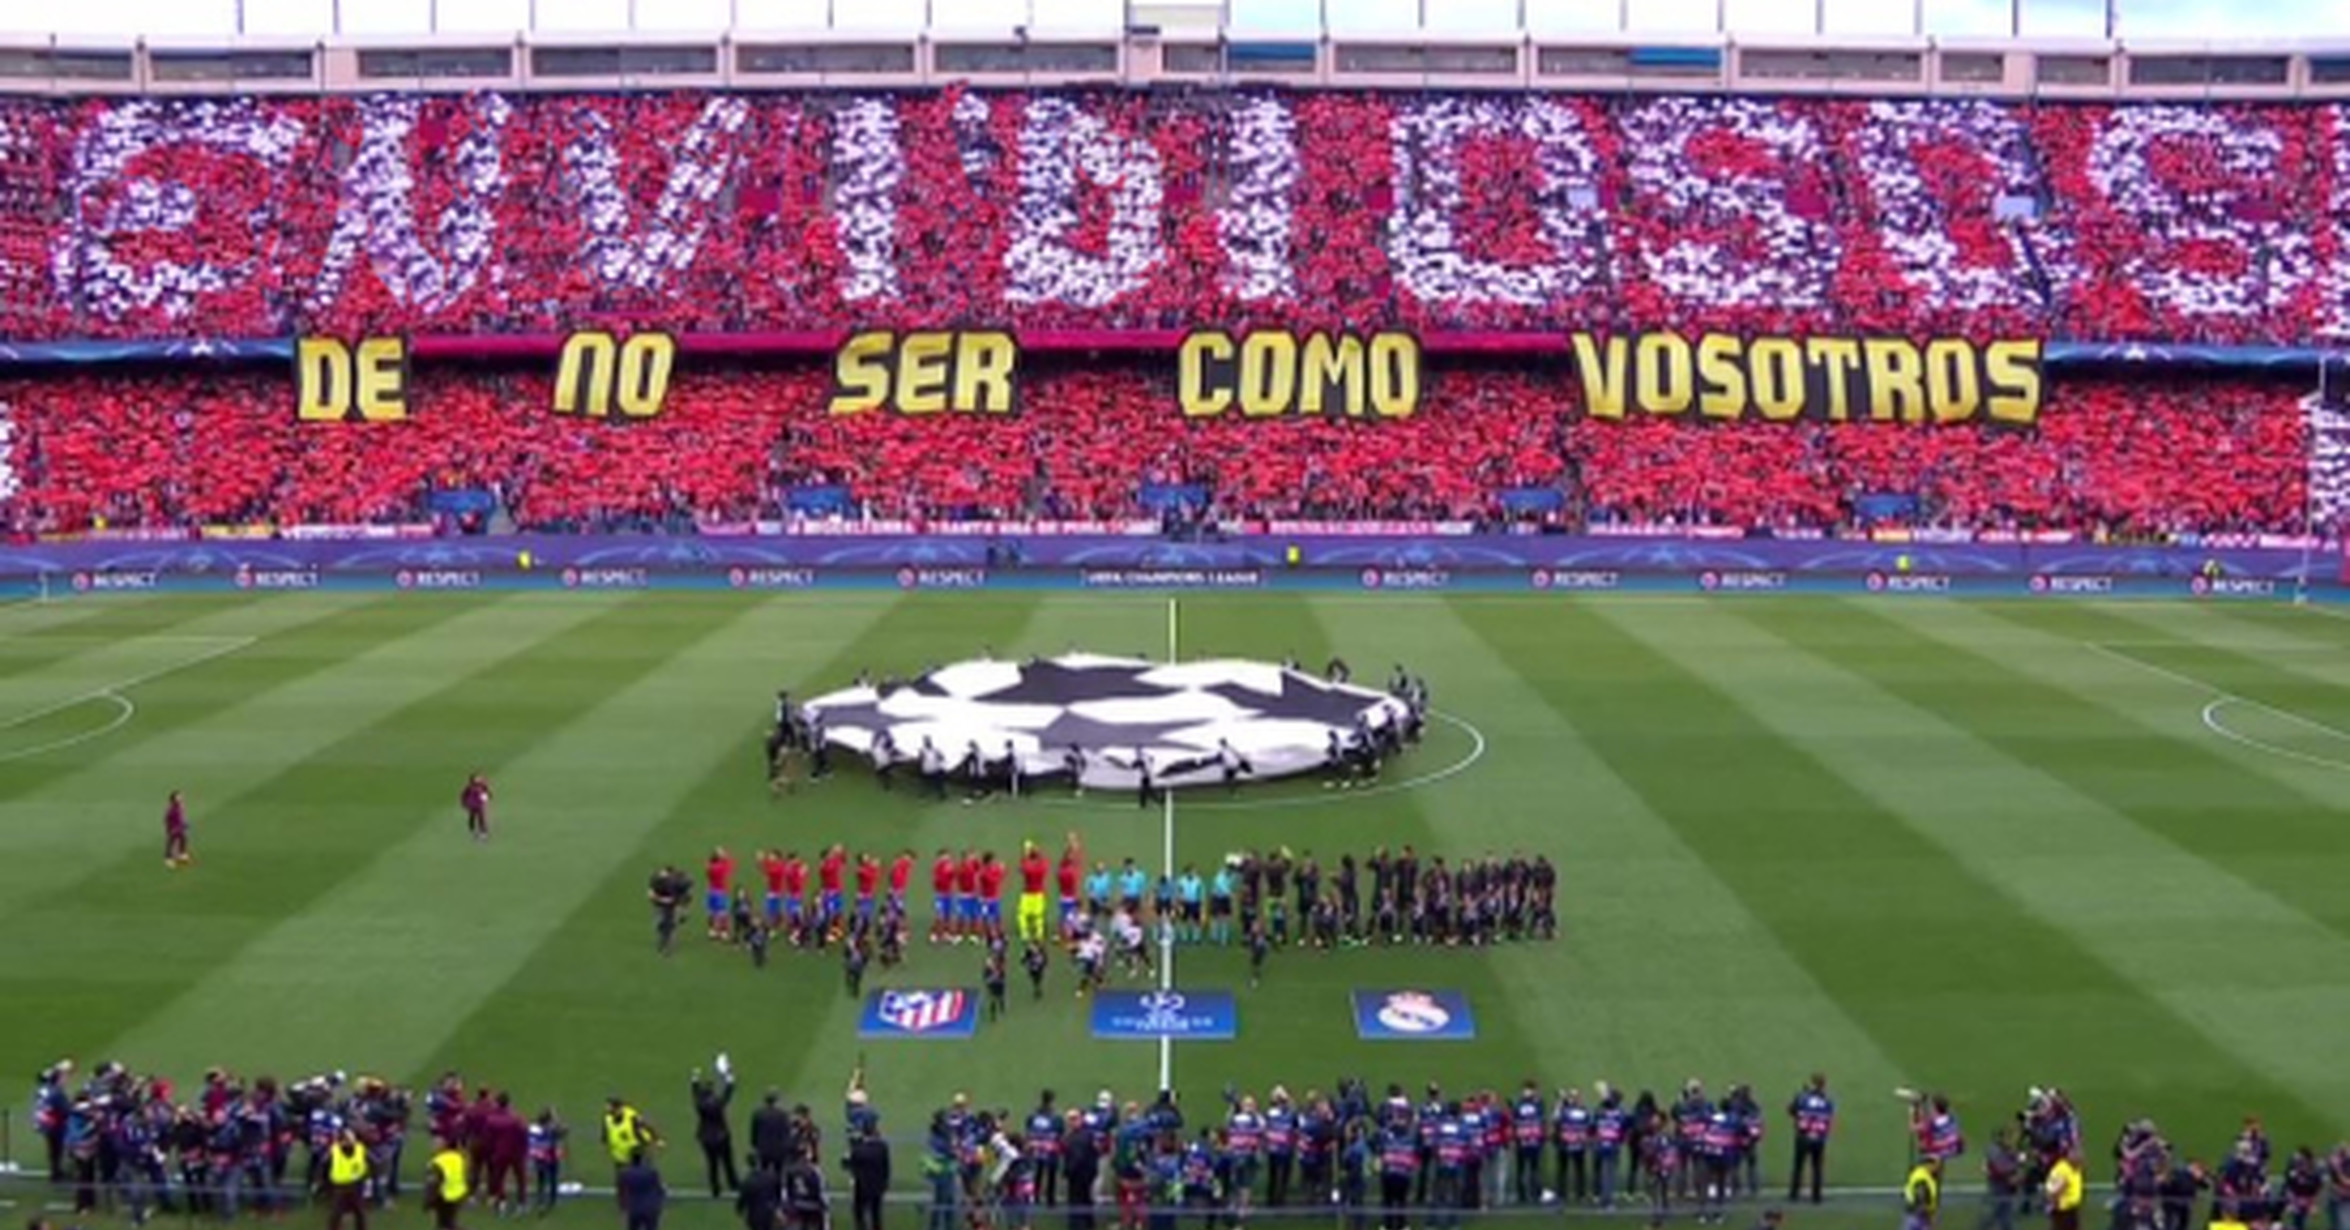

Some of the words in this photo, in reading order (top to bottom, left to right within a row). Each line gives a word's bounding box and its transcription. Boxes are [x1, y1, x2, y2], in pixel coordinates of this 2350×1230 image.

[297, 337, 408, 422] DE
[553, 331, 675, 417] NO
[829, 331, 1018, 417] SER
[1178, 332, 1420, 418] COMO
[1572, 332, 2041, 425] VOSOTROS
[93, 572, 156, 587] RESPECT
[256, 571, 319, 586] RESPECT
[417, 571, 480, 586] RESPECT
[581, 570, 648, 585] RESPECT
[749, 569, 814, 585] RESPECT
[918, 569, 986, 585] RESPECT
[1384, 569, 1449, 585] RESPECT
[1552, 571, 1618, 586] RESPECT
[1721, 572, 1786, 587] RESPECT
[1888, 575, 1951, 589] RESPECT
[2050, 577, 2113, 591] RESPECT
[2212, 579, 2275, 593] RESPECT
